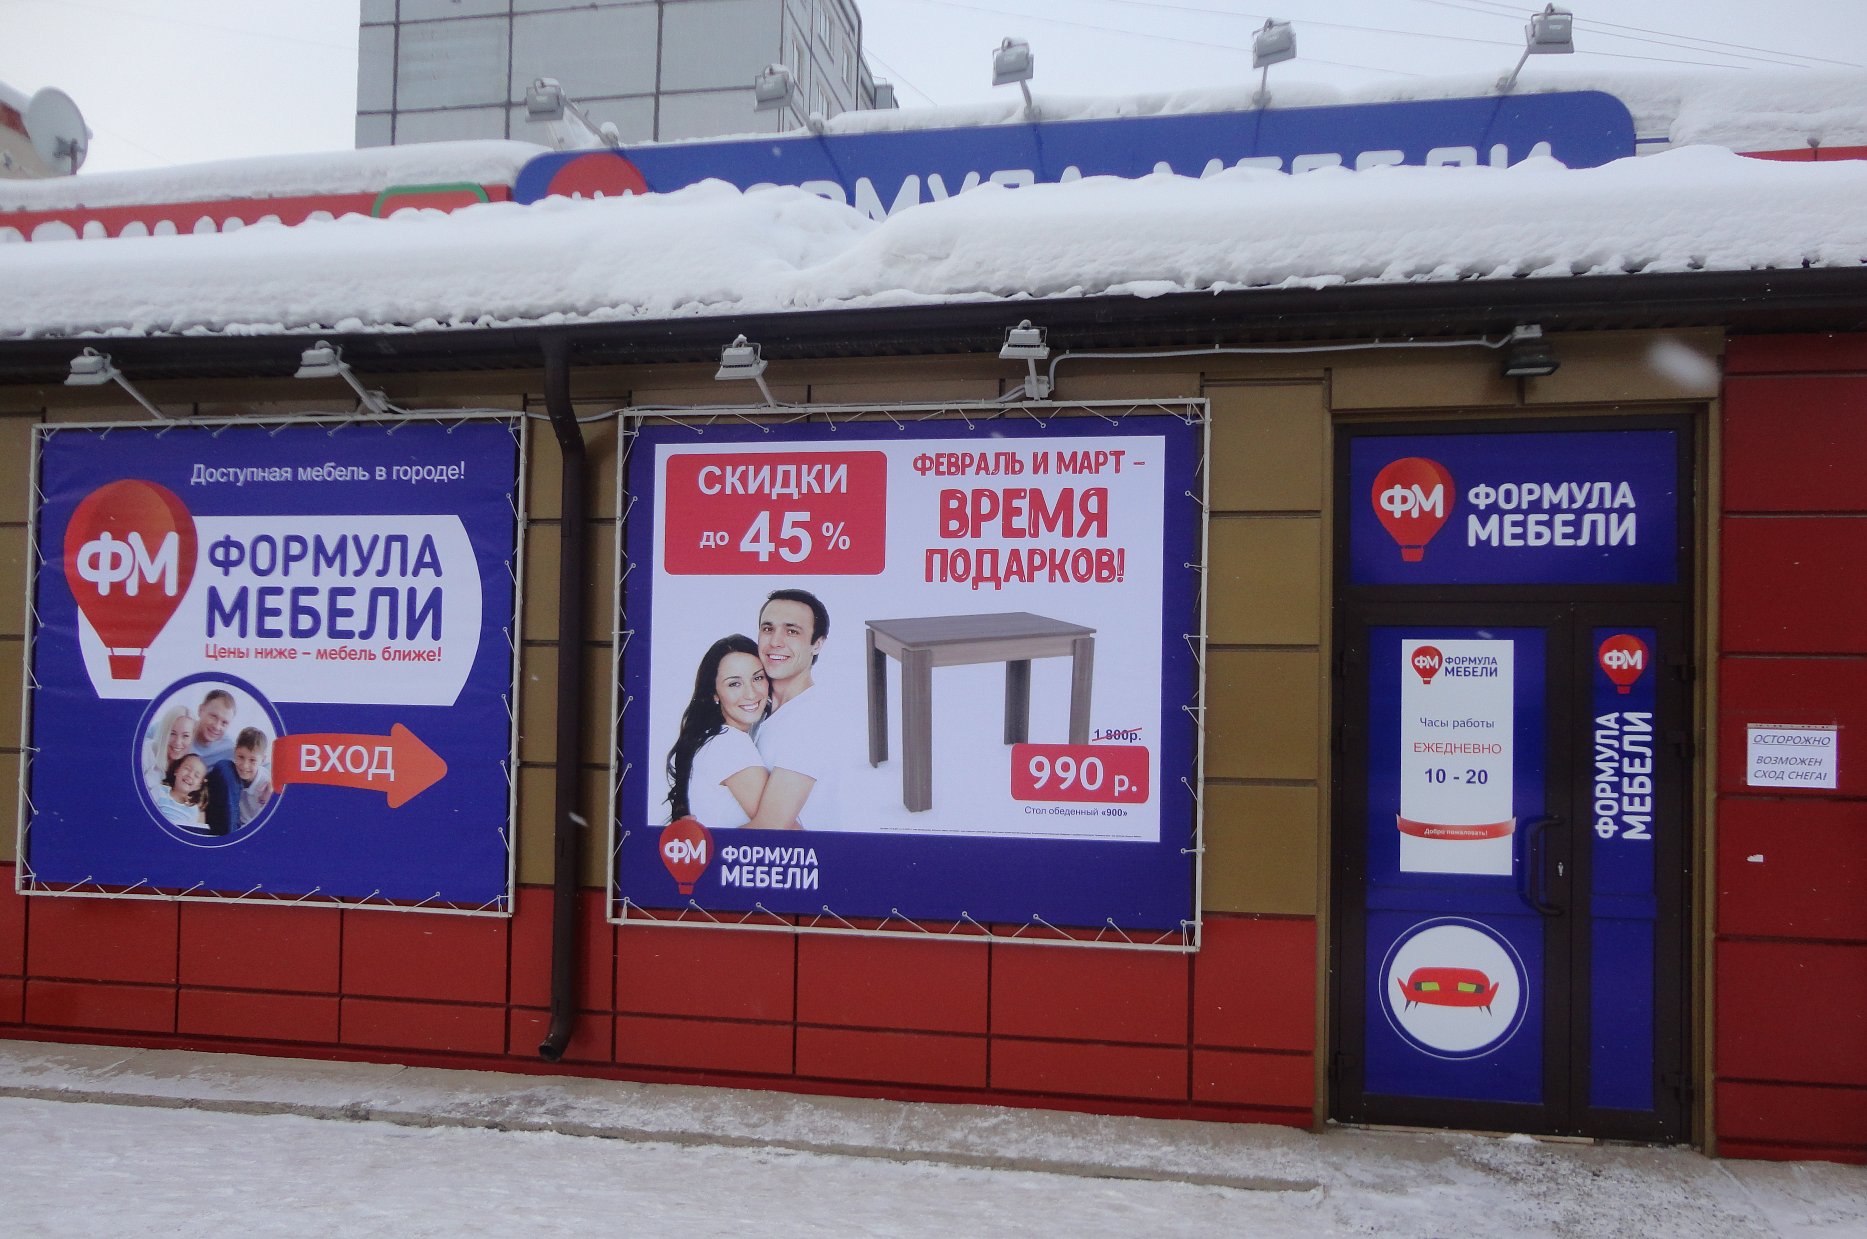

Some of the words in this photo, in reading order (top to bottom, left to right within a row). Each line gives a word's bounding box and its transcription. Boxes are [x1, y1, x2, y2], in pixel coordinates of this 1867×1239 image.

[190, 463, 292, 486] Доступная
[297, 461, 371, 482] мебель
[375, 465, 387, 481] в
[392, 460, 465, 484] городе!
[912, 450, 1025, 477] ФЕВРАЛЬ
[1031, 450, 1051, 475] И
[1056, 450, 1126, 475] МАРТ
[697, 464, 848, 499] СКИДКИ
[1379, 483, 1444, 519] ФМ
[1466, 481, 1637, 510] ФОРМУЛА
[938, 487, 1109, 540] ВРЕМЯ
[699, 528, 730, 549] до
[738, 510, 814, 563] 45
[820, 521, 851, 551] %
[1466, 513, 1637, 547] МЕБЕЛИ
[76, 530, 179, 597] ФМ
[207, 533, 443, 578] ФОРМУЛА
[924, 546, 1126, 591] ПОДАРКОВ!
[205, 585, 443, 641] МЕБЕЛИ
[204, 643, 250, 661] Цены
[254, 647, 298, 661] ниже
[315, 645, 377, 661] мебель
[381, 645, 442, 662] ближе!
[1414, 655, 1439, 669] ФМ
[1444, 656, 1498, 666] ФОРМУЛА
[1603, 649, 1644, 671] ФМ
[1444, 666, 1498, 677] МЕБЕЛИ
[1419, 717, 1449, 729] Часы
[1452, 717, 1495, 730] работы
[1413, 742, 1502, 755] ЕЖЕДНЕВНО
[1753, 734, 1831, 746] ОСТОРОЖНО
[299, 745, 395, 782] ВХОД
[1756, 755, 1823, 767] ВОЗМОЖЕН
[1028, 755, 1104, 791] 990
[1113, 774, 1138, 796] р.
[1424, 768, 1446, 784] 10
[1465, 769, 1488, 784] 20
[1594, 712, 1620, 839] ФОРМУЛА
[1622, 711, 1653, 841] МЕБЕЛИ
[1753, 769, 1785, 781] СХОД
[1787, 770, 1828, 781] СНЕГА!
[1024, 806, 1047, 815] Стол
[1049, 806, 1099, 817] обеденный
[1423, 827, 1446, 836] Добро
[1446, 828, 1488, 837] пожаловать!
[664, 837, 707, 865] ФМ
[721, 845, 819, 867] ФОРМУЛА
[720, 865, 819, 890] МЕБЕЛИ
